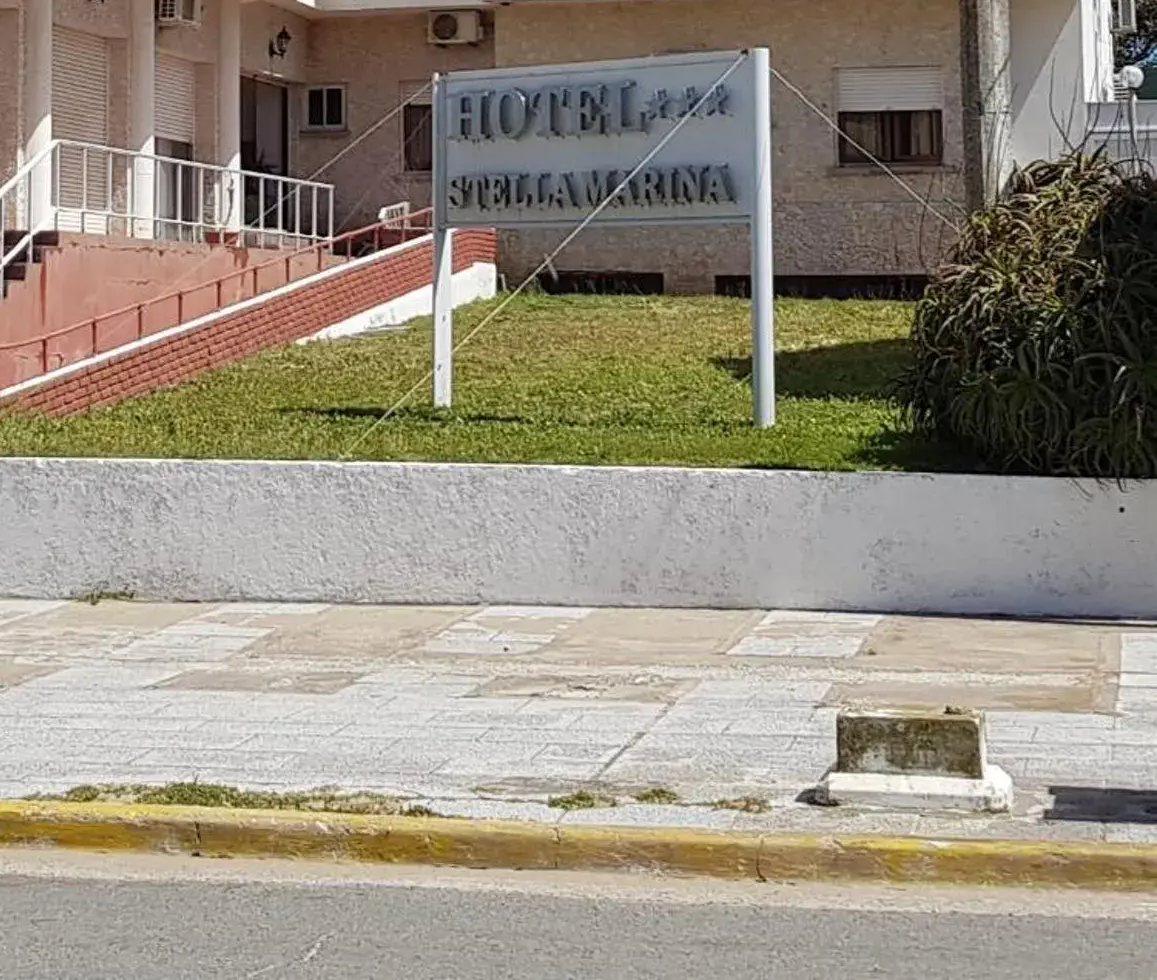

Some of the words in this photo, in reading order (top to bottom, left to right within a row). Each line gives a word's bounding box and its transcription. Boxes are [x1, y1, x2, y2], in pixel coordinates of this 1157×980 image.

[448, 80, 646, 141] HOTEL
[448, 171, 581, 212] STELLA
[584, 163, 738, 210] MARINA
